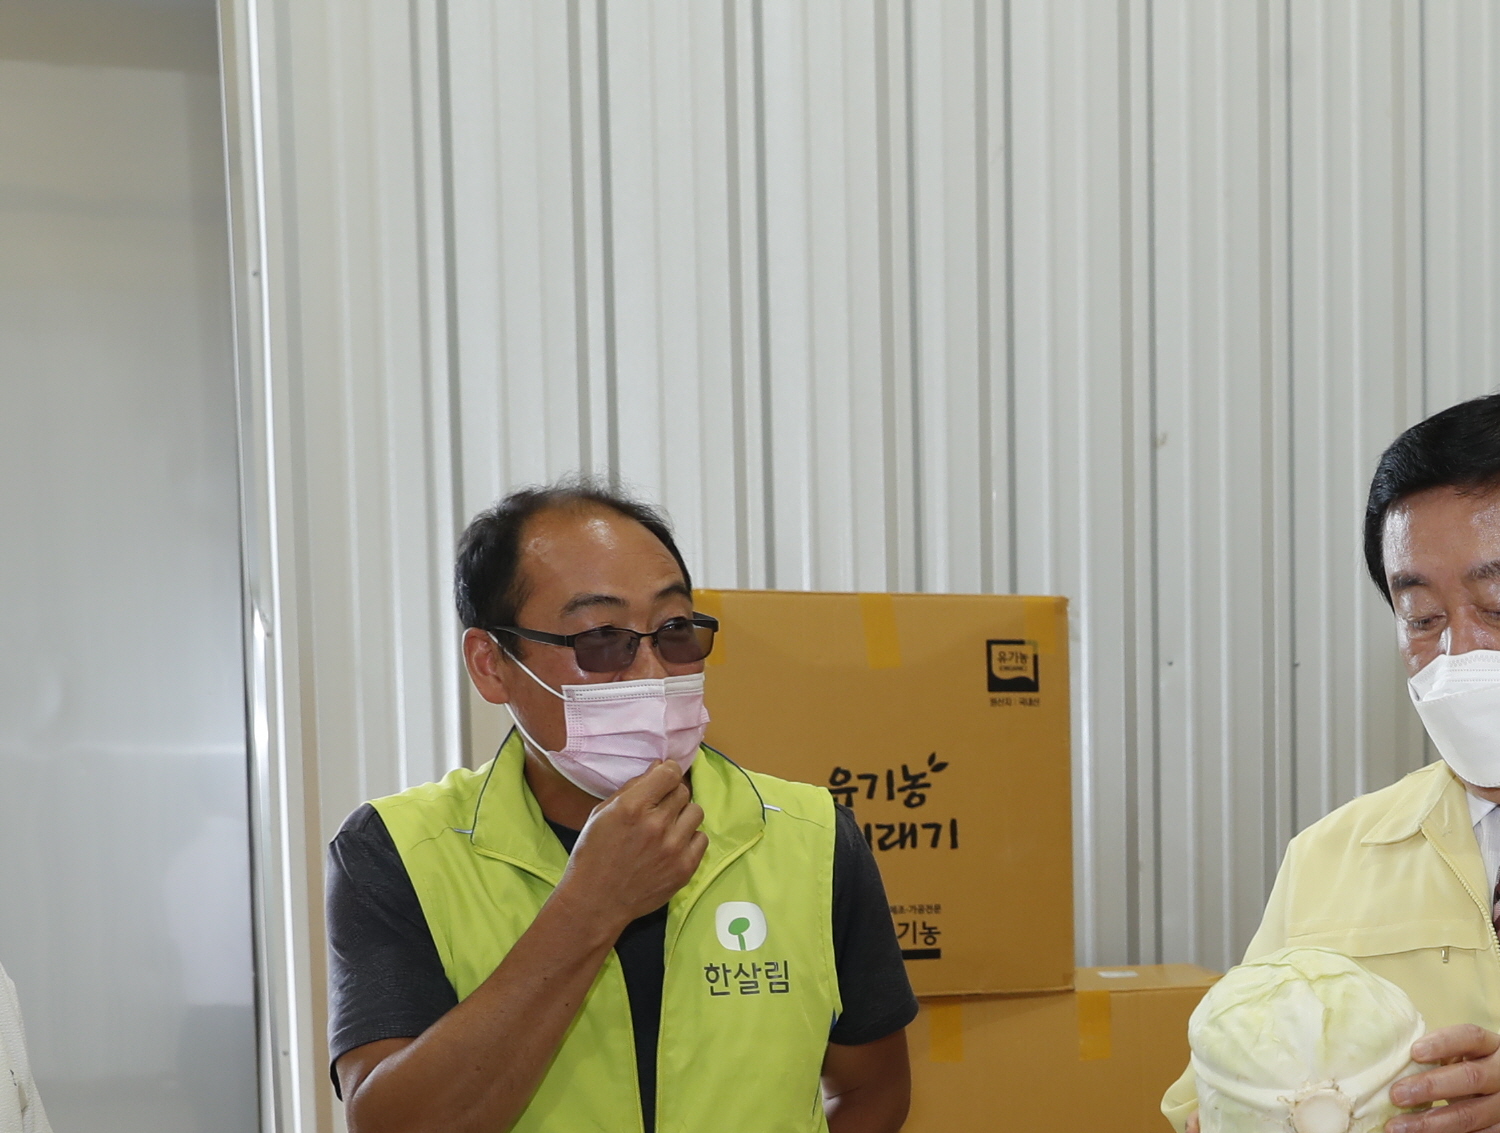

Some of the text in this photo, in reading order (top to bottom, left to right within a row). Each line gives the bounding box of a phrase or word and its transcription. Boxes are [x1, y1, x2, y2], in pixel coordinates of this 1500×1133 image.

[998, 651, 1028, 664] 유기농
[829, 764, 931, 808] 유기농
[864, 818, 959, 851] 래기
[703, 960, 790, 996] 한살림
